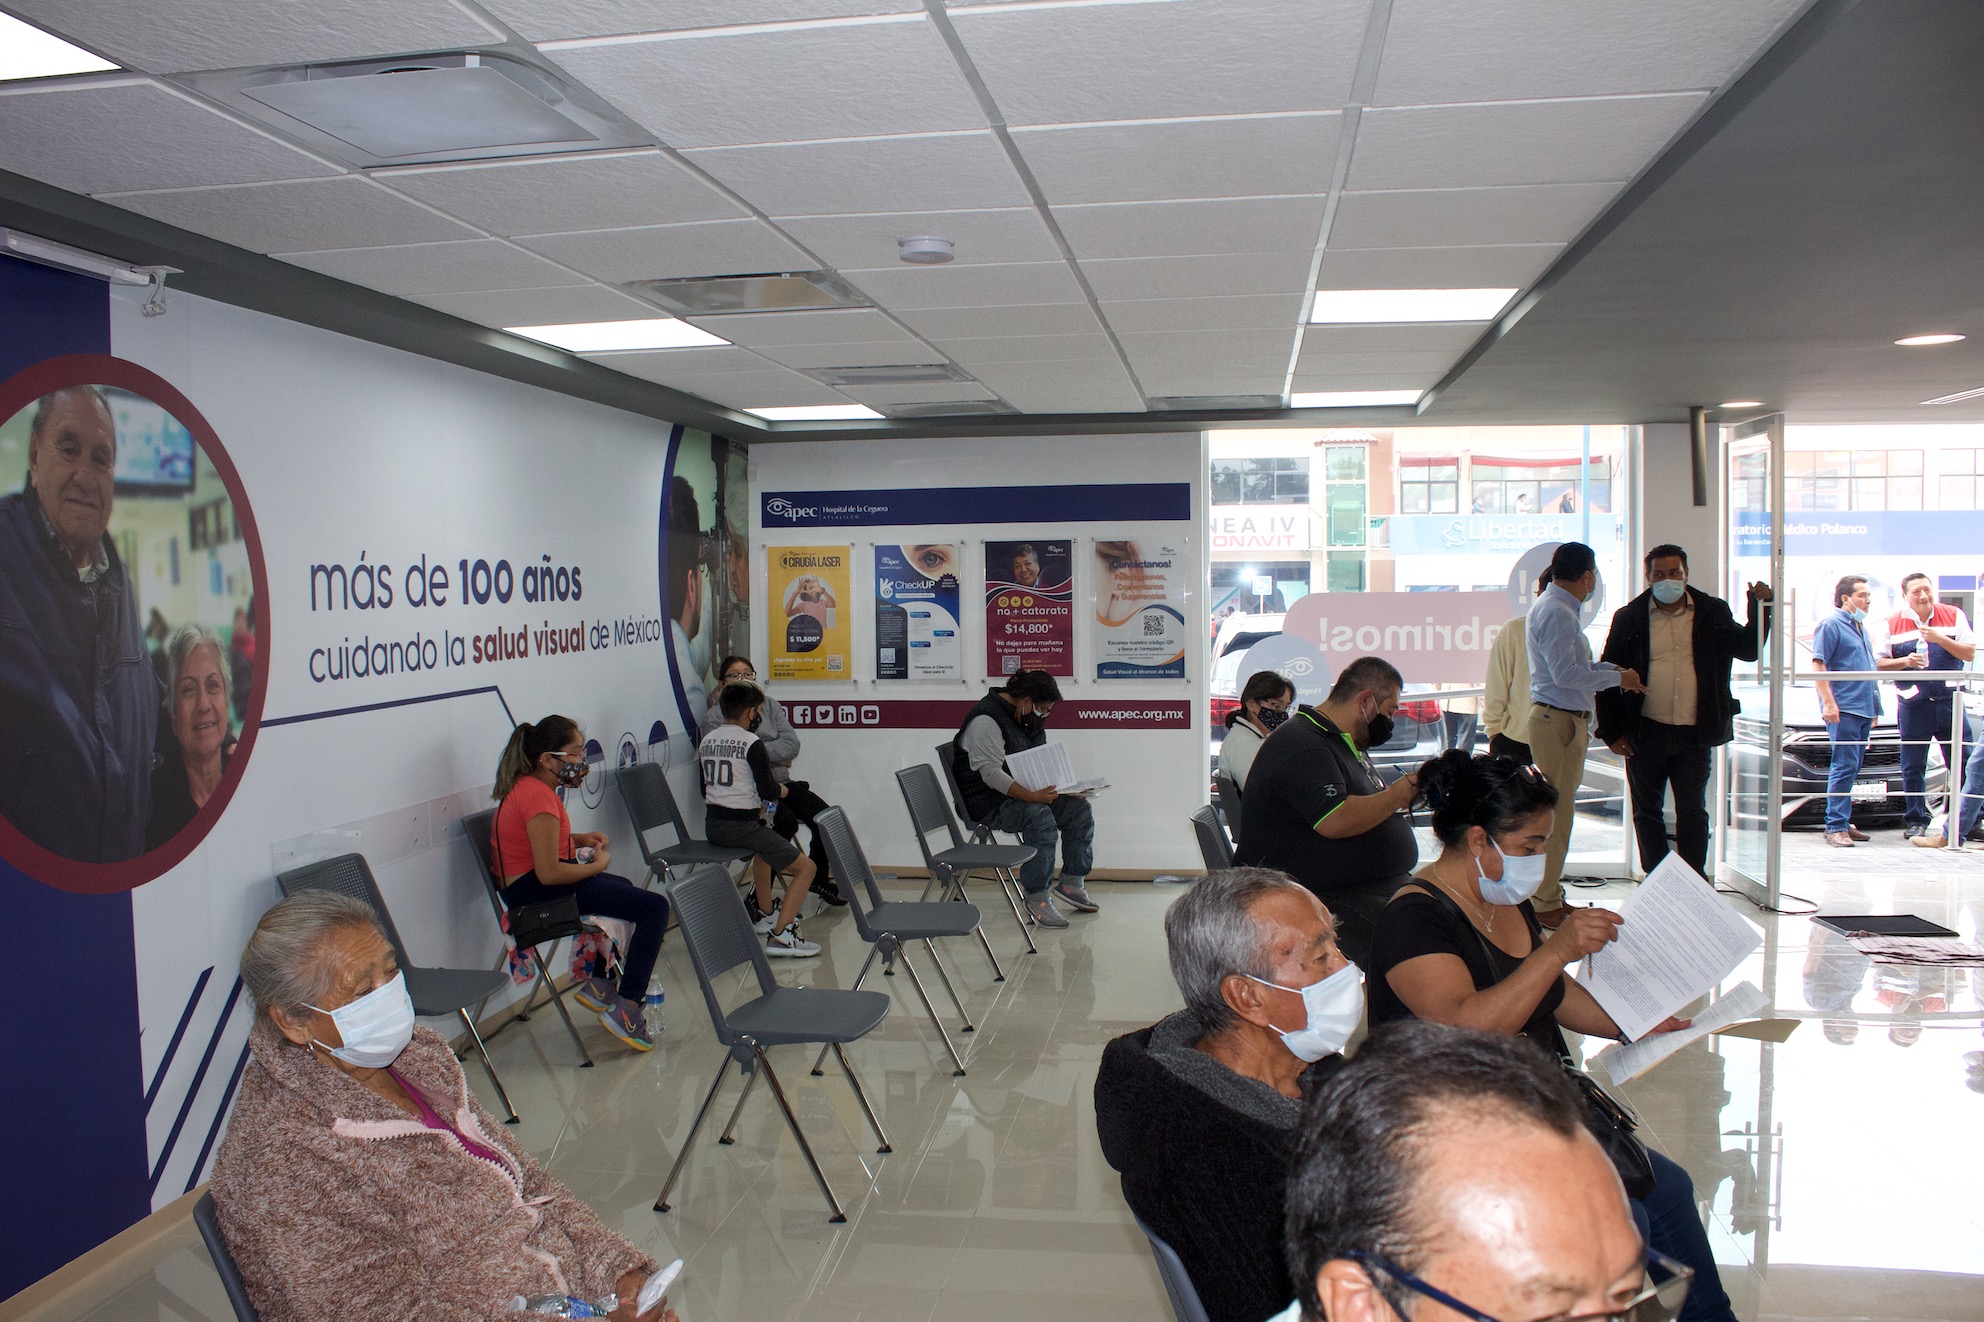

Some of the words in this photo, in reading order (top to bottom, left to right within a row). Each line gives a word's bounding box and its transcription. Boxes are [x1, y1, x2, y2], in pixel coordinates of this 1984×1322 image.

[784, 506, 818, 522] apec
[823, 505, 848, 514] Hospital
[848, 505, 856, 513] de
[863, 504, 889, 514] Ceguera
[1210, 517, 1257, 534] NEA
[1270, 516, 1295, 533] IV
[1468, 519, 1564, 541] Libertad
[1820, 523, 1868, 535] Polanco
[1212, 535, 1296, 548] ONAVIT
[818, 556, 841, 567] LASER
[310, 550, 394, 611] más
[405, 553, 449, 608] de
[459, 558, 514, 605] 100
[522, 554, 583, 603] años
[895, 580, 936, 590] CheckUP
[997, 608, 1010, 616] no
[1021, 606, 1069, 616] catarata
[309, 632, 437, 683] cuidando
[445, 629, 465, 667] la
[472, 624, 529, 664] salud
[533, 620, 585, 656] visual
[590, 619, 610, 650] de
[614, 614, 661, 647] México
[1016, 646, 1039, 654] puedes
[1051, 646, 1063, 654] hoy
[1078, 710, 1184, 721] www.apec.org.mx
